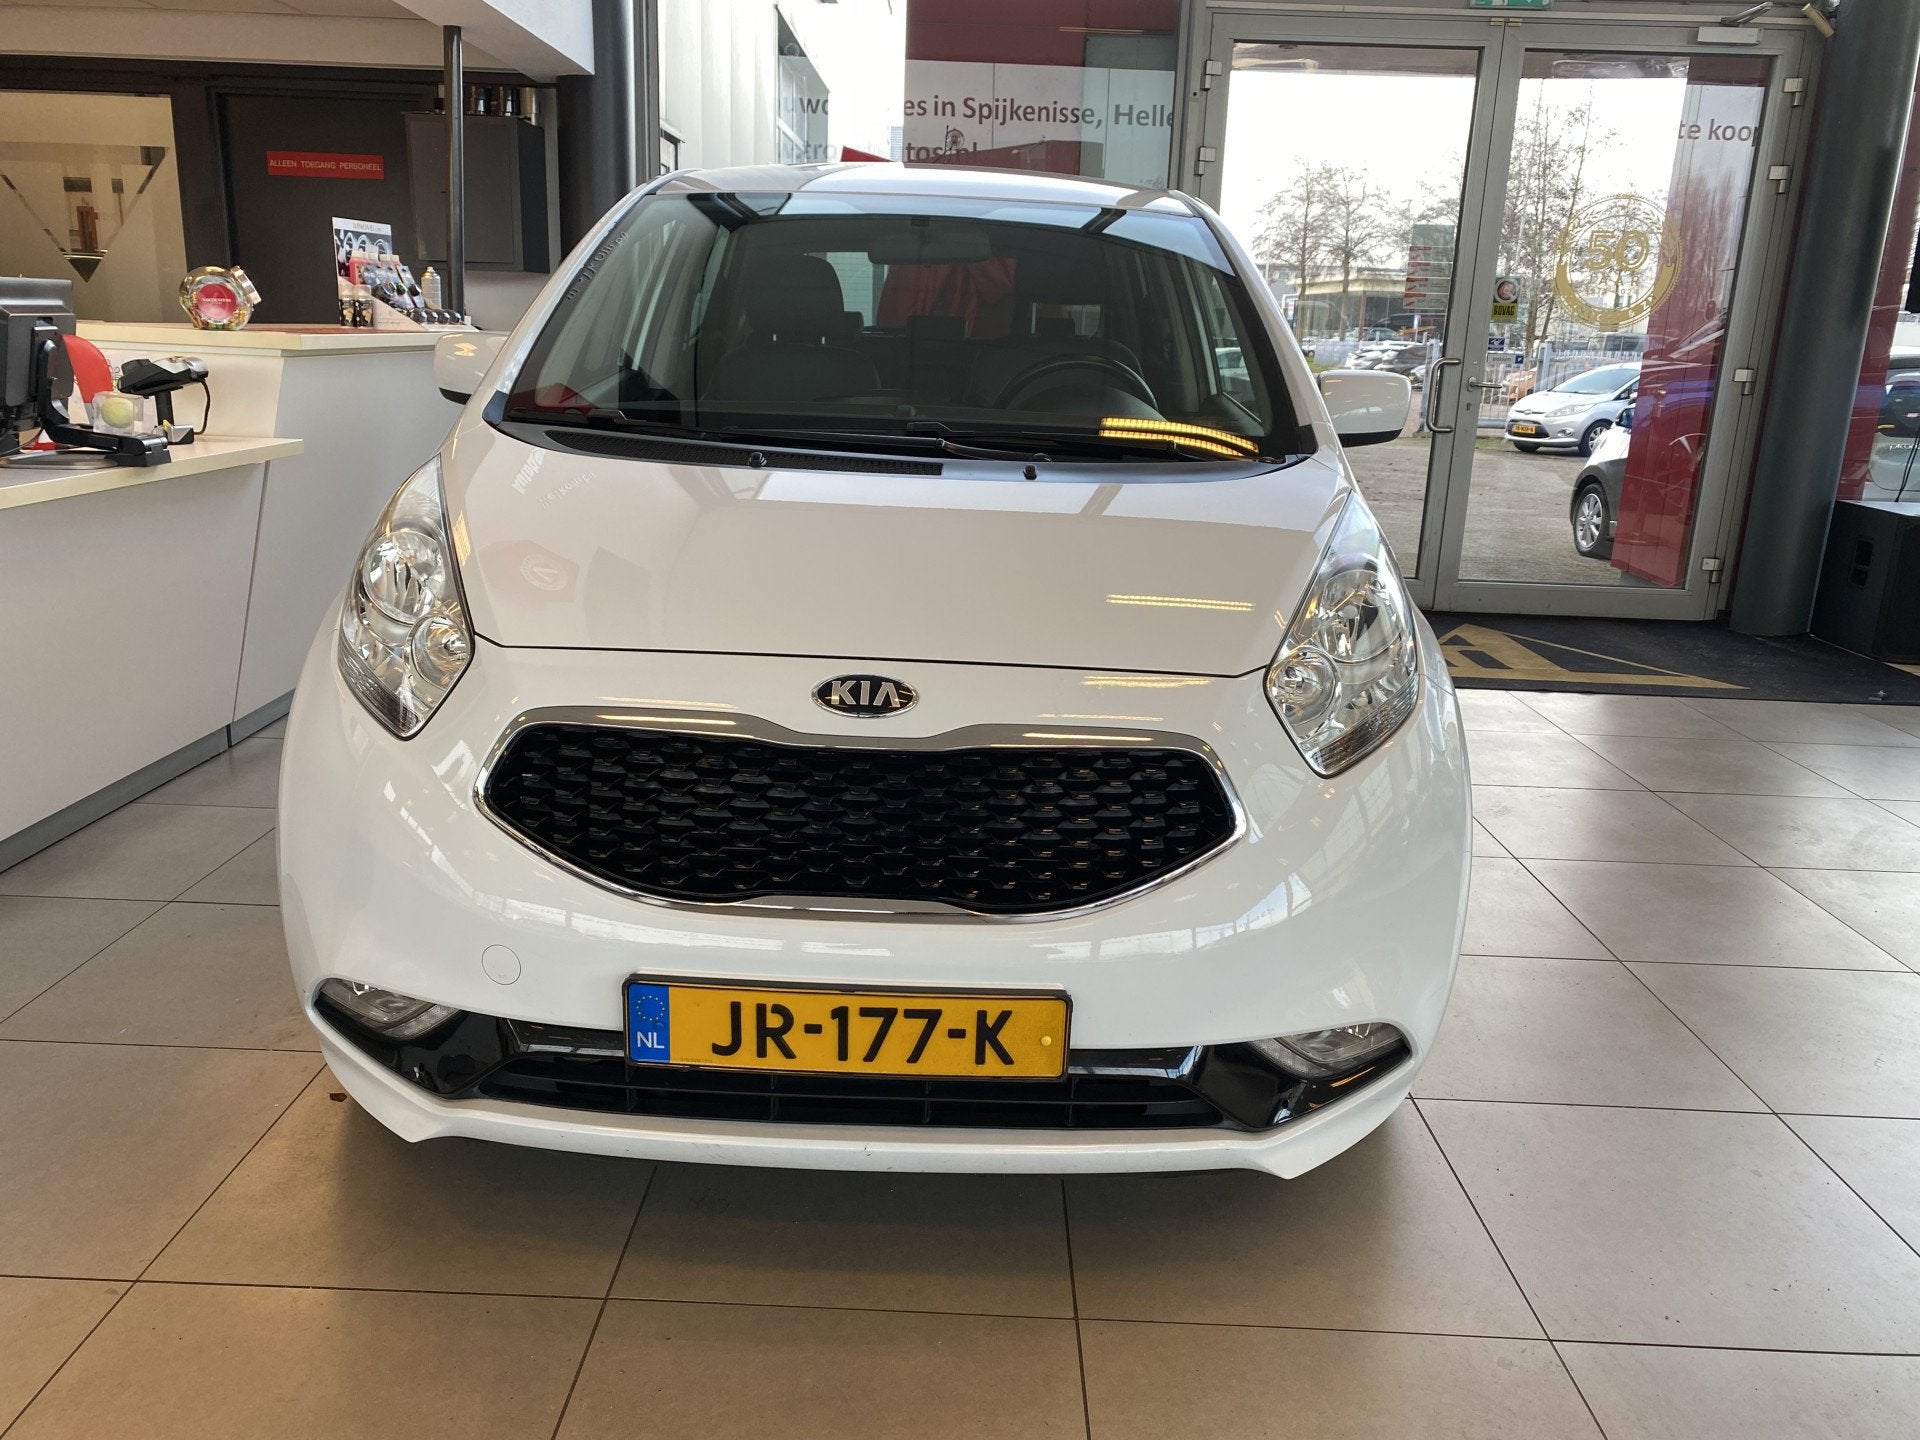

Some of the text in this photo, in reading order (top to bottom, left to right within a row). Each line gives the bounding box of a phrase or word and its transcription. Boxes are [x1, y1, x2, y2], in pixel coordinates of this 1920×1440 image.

[934, 94, 956, 117] in
[963, 96, 1103, 129] Spijkenisse,
[1677, 120, 1702, 140] te
[269, 159, 382, 171] ALLEEN TOEGANG PERSONEEL
[1584, 229, 1649, 272] 50
[1493, 305, 1515, 316] BOVAG
[831, 680, 901, 708] KIA
[636, 1030, 665, 1050] NL
[711, 1000, 1015, 1066] JR-177-K
